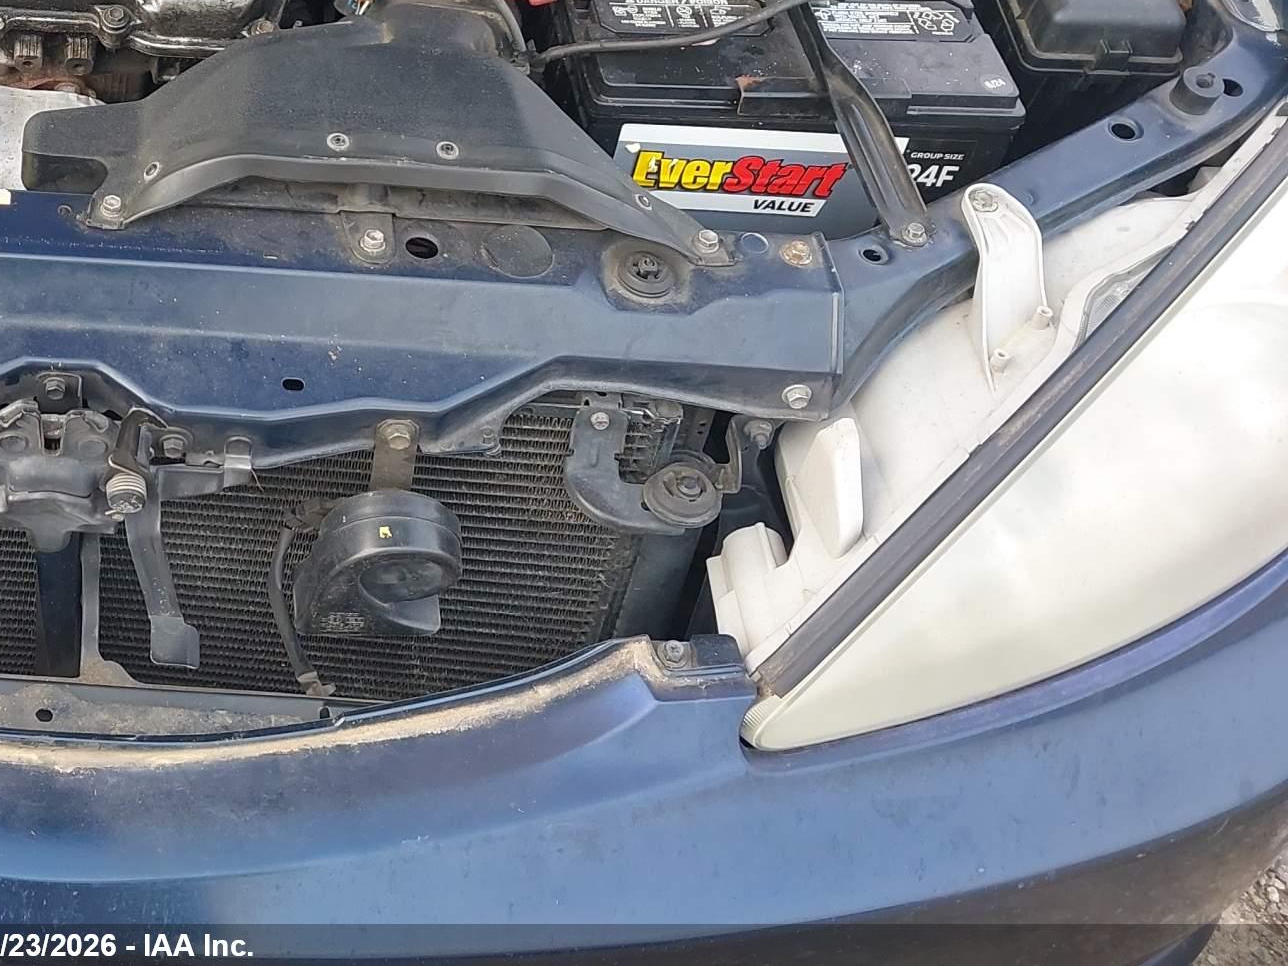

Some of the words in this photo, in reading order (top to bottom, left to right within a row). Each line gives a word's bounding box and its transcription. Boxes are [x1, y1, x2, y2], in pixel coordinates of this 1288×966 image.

[910, 151, 943, 159] GROUP
[943, 153, 966, 161] SIZE
[632, 150, 849, 198] EverStart
[753, 198, 814, 214] VALUE
